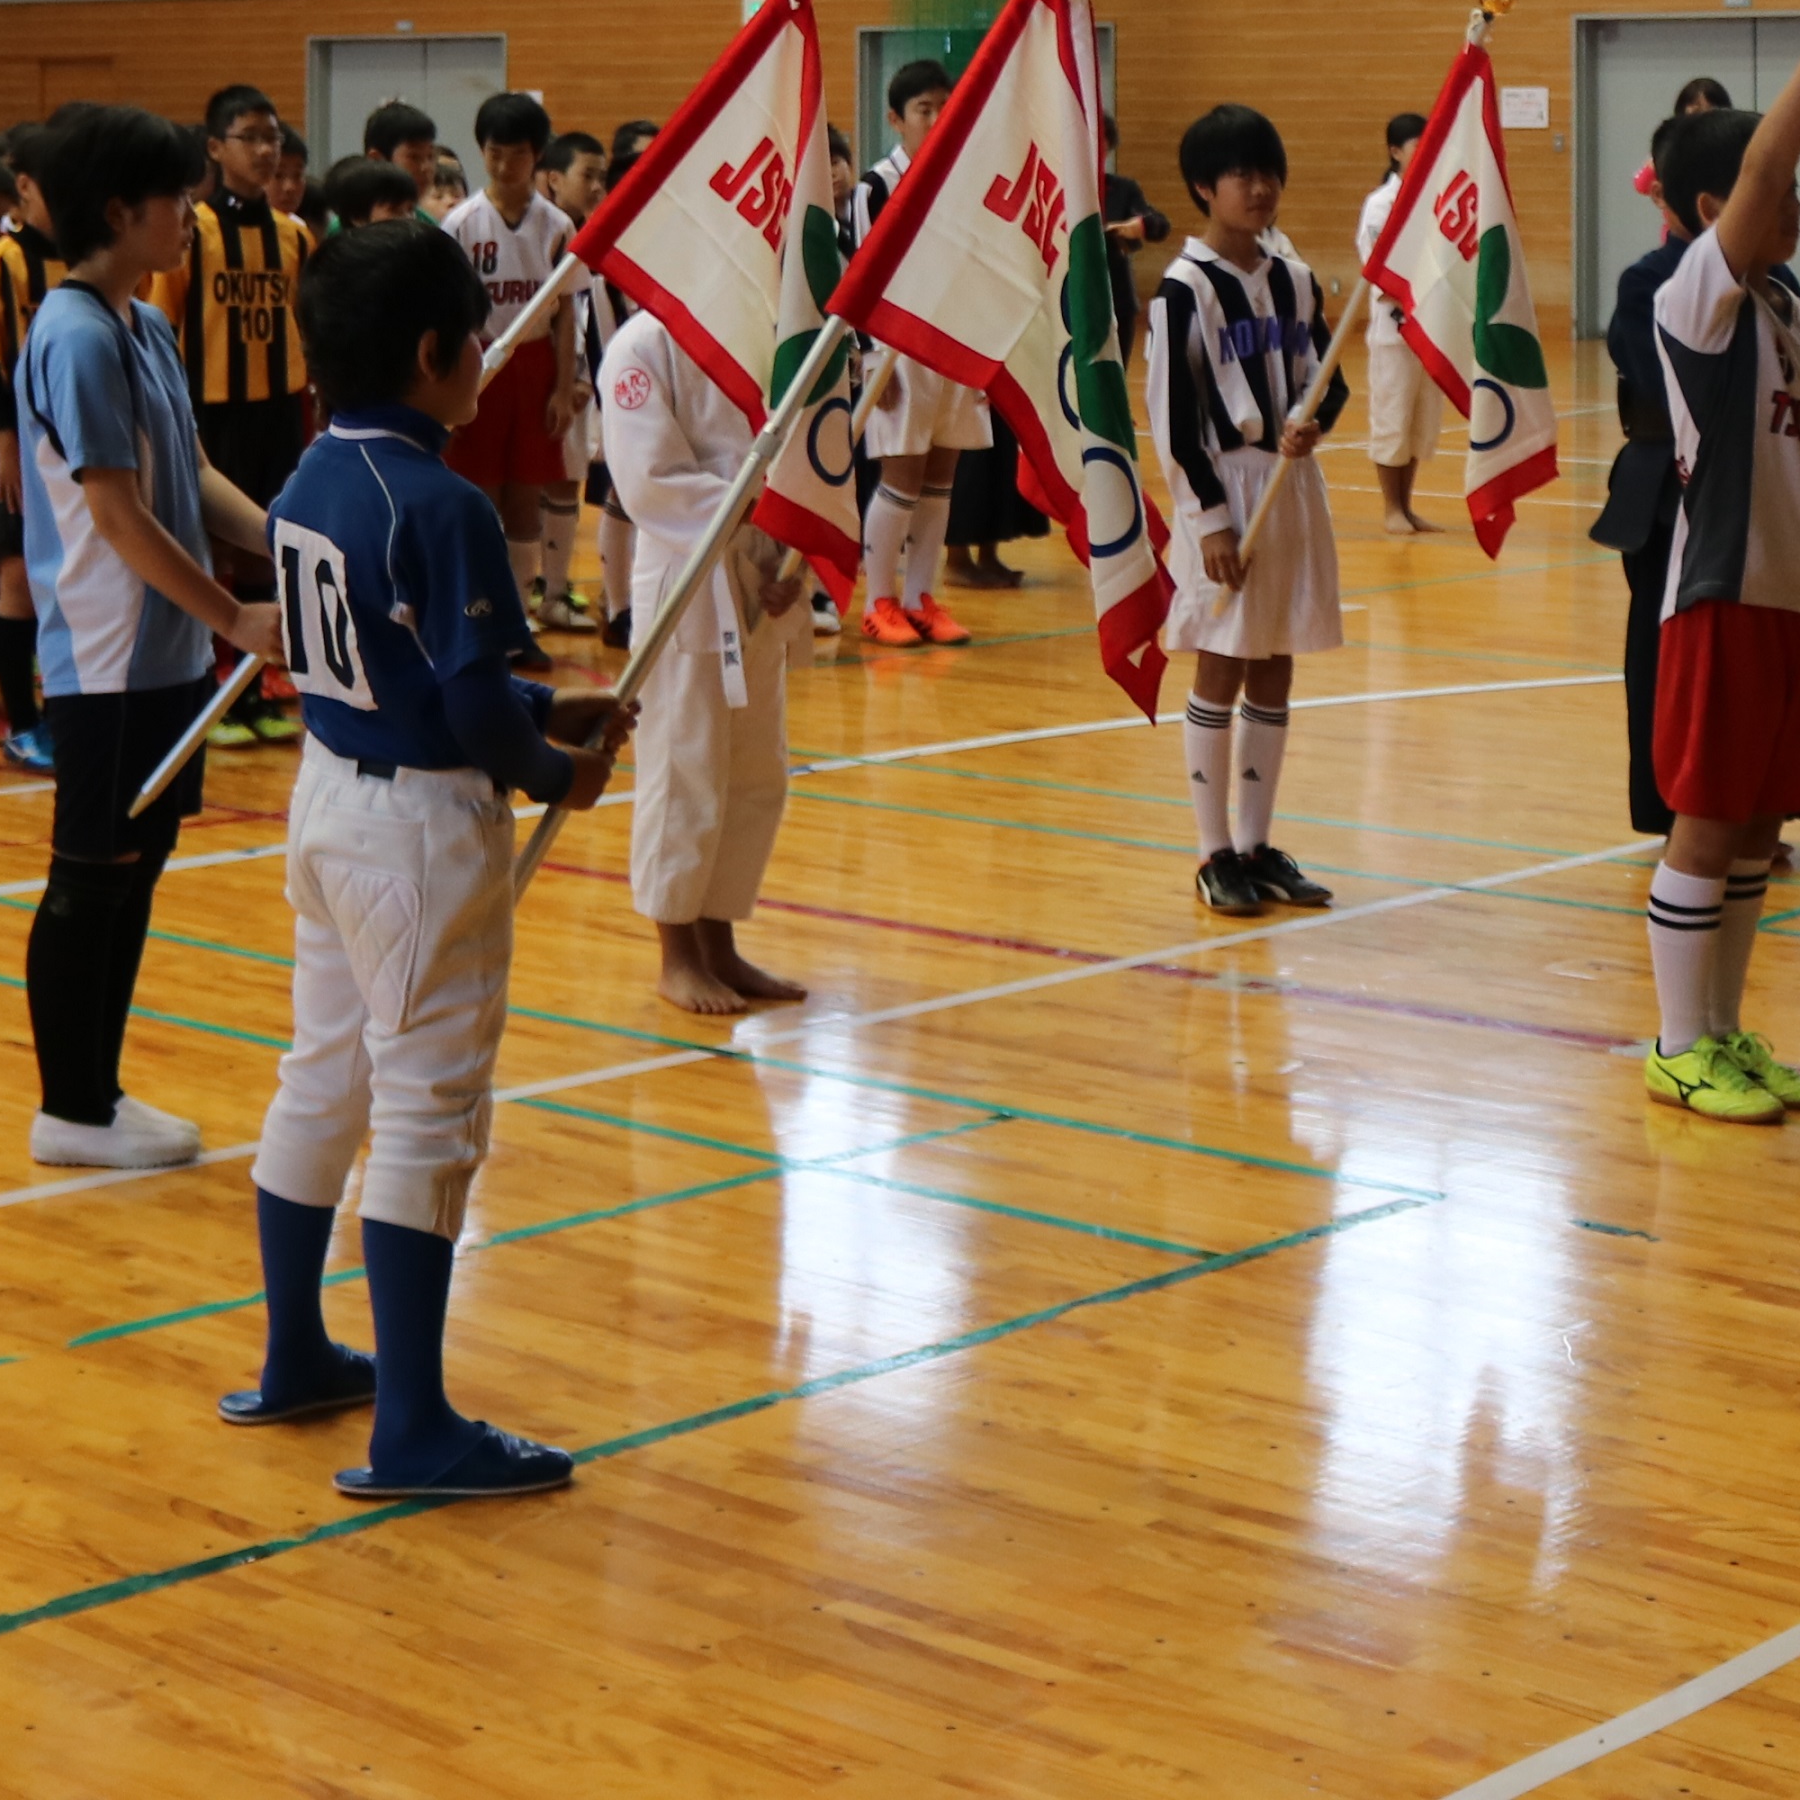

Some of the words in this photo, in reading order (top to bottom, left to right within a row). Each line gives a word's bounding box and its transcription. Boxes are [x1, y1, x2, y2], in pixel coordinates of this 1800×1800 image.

[472, 240, 498, 275] 18
[241, 307, 270, 341] 10
[281, 544, 356, 691] 10
